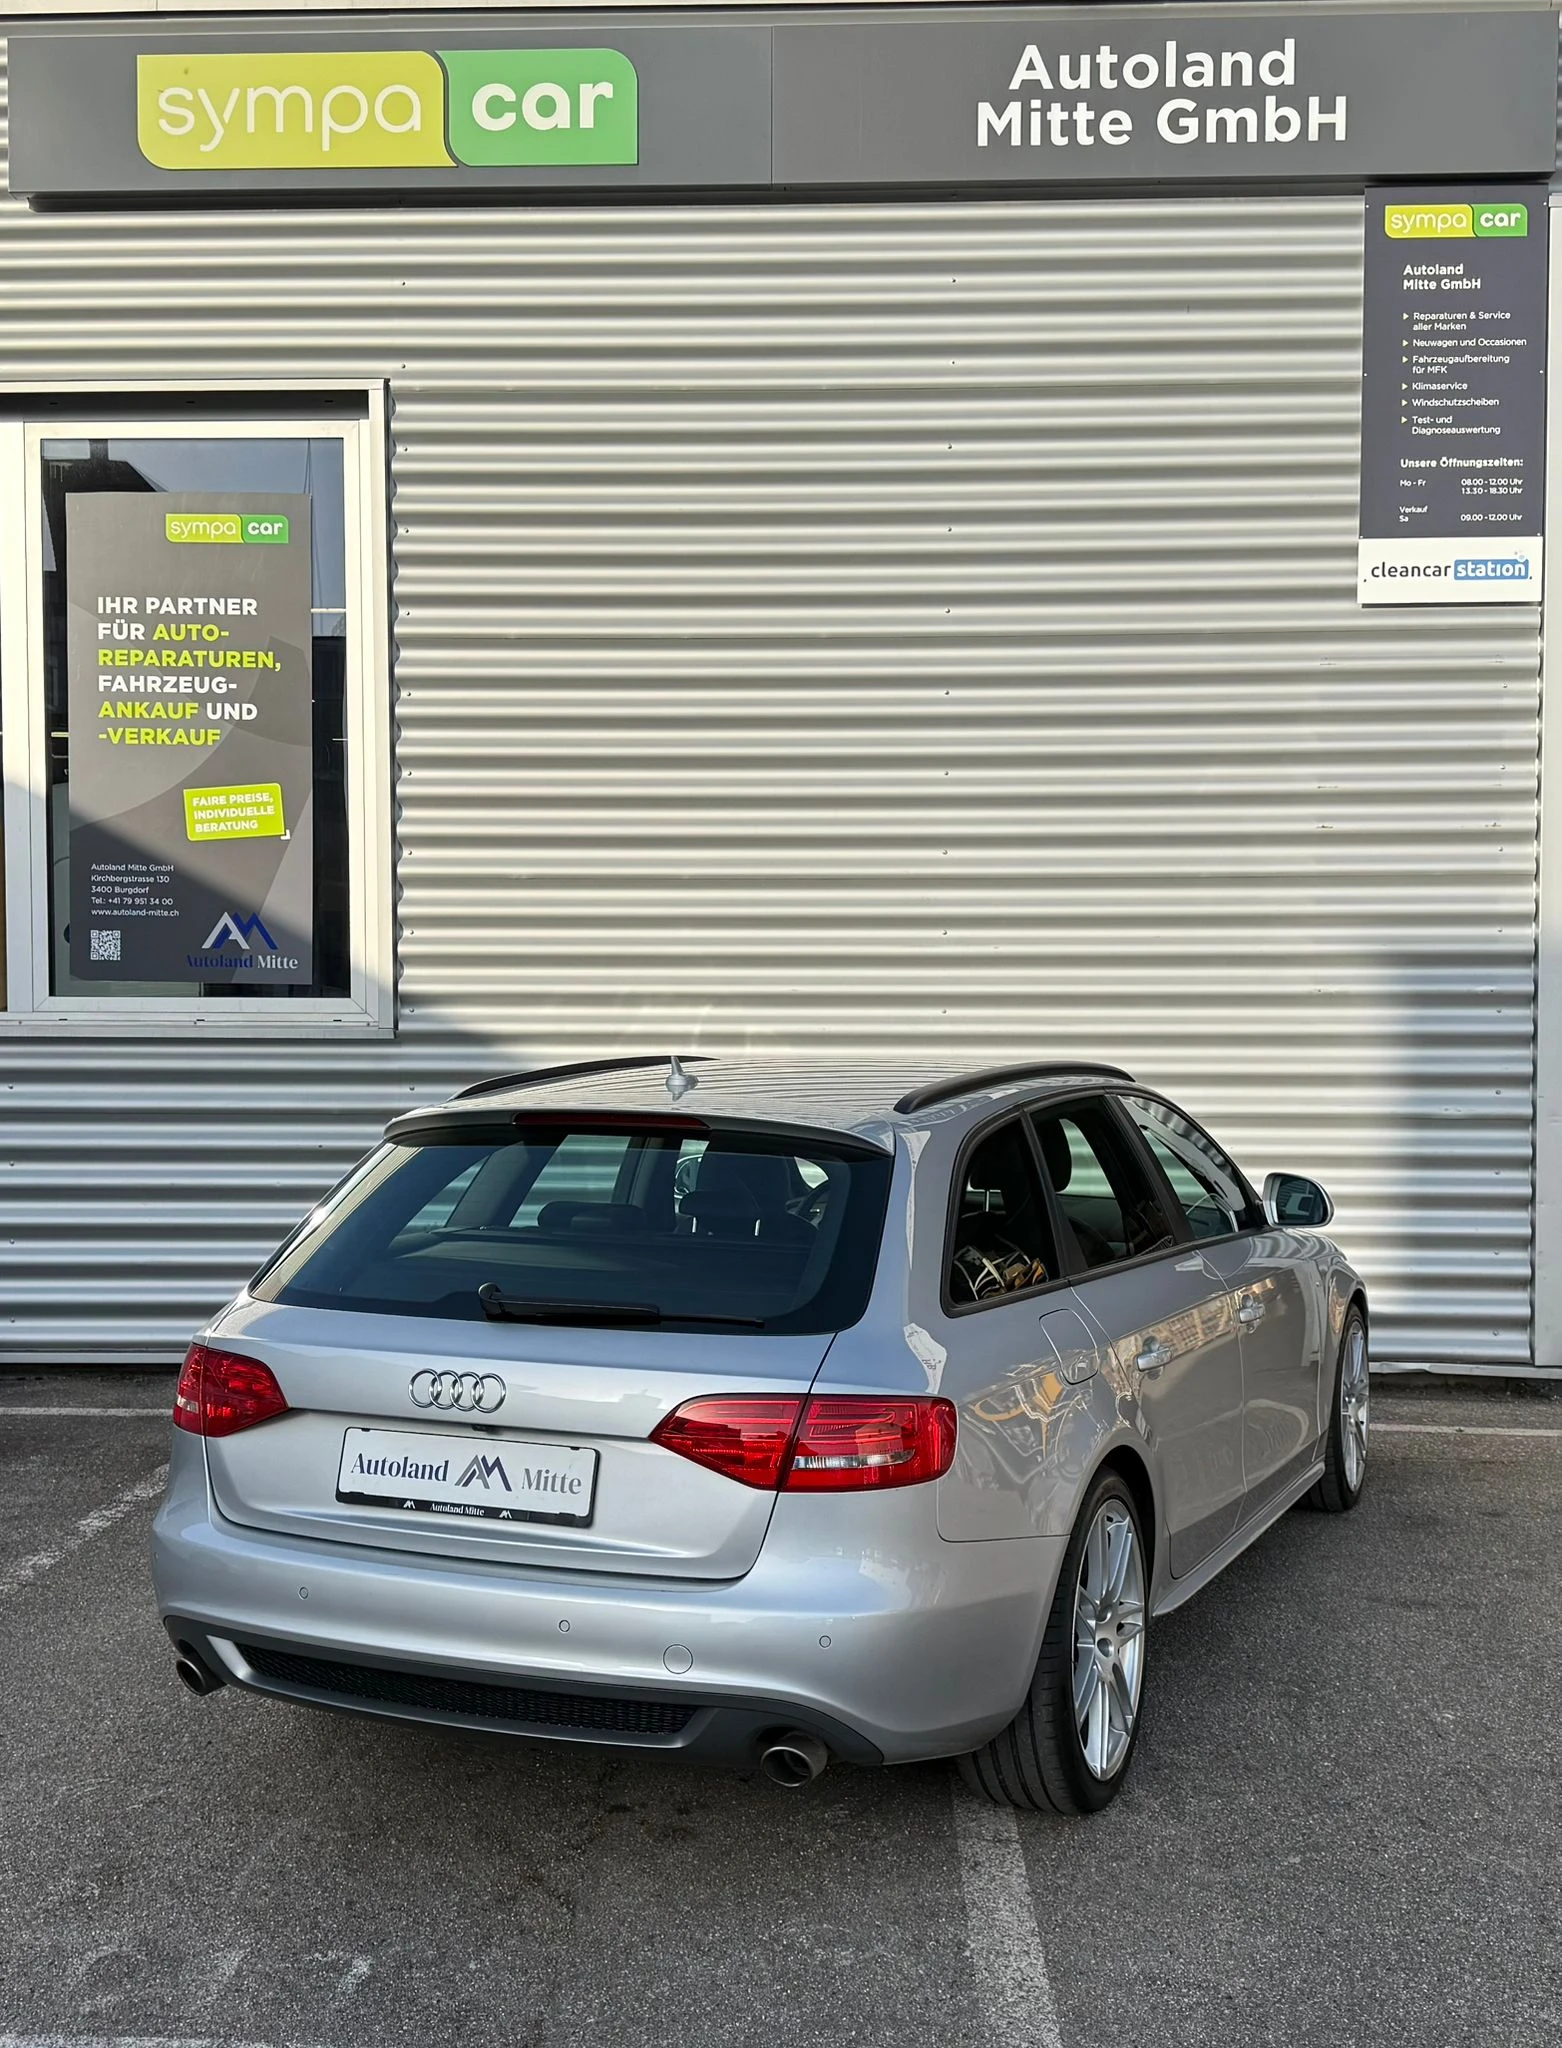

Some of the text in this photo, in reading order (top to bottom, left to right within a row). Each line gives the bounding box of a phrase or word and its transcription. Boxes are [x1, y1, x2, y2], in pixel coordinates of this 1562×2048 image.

[1008, 38, 1297, 91] Autoland
[157, 81, 614, 152] sympa car
[976, 95, 1348, 147] Mitte GmbH
[1390, 211, 1521, 233] sympa car
[1402, 263, 1464, 276] Autoland
[1402, 278, 1482, 290] Mitte GmbH
[1413, 311, 1511, 322] Reparaturen & Service
[1412, 322, 1467, 331] aller Marken
[1412, 337, 1527, 348] Neuwagen und Occasionen
[1412, 354, 1510, 365] Fahrzeugaufbereitung
[1412, 365, 1448, 374] für MFK
[1412, 382, 1468, 391] Klimaservice
[1411, 397, 1500, 407] Windschutzscheiben
[1411, 415, 1453, 424] Test- und
[1411, 426, 1501, 435] Diagnoseauswertung
[1400, 456, 1524, 469] Unsere Öffnungszeiten:
[1399, 479, 1412, 487] Mo
[1417, 479, 1426, 487] Fr
[1461, 478, 1484, 486] 08.00
[1488, 478, 1508, 486] 12.00
[1509, 478, 1523, 486] Uhr
[1461, 487, 1484, 495] 13.30
[1489, 487, 1508, 495] 18.30
[1399, 505, 1428, 514] Verkauf
[1399, 514, 1409, 522] Sa
[1460, 514, 1484, 522] 09.00
[1508, 513, 1522, 521] Uhr
[170, 520, 284, 539] sympa car
[1371, 561, 1527, 578] cleancar station
[98, 596, 258, 616] IHR PARTNER
[98, 618, 230, 642] FÜR AUTO-
[98, 649, 281, 671] REPARATUREN,
[98, 675, 238, 694] FAHRZEUG-
[98, 701, 258, 721] ANKAUF UND
[98, 728, 221, 746] -VERKAUF
[192, 792, 274, 807] FAIRE PREISE,
[193, 805, 276, 820] INDIVIDUELLE
[195, 819, 259, 833] BERATUNG
[91, 863, 126, 871] Autoland
[149, 864, 174, 872] GmbH
[91, 875, 170, 884] Kirchbergstrasse 130
[114, 886, 149, 894] Burgdorf
[123, 897, 132, 905] 79
[134, 897, 148, 905] 951
[91, 908, 180, 917] www.autoland-mitte.ch
[186, 954, 299, 969] Autoland Mitte
[351, 1452, 449, 1483] Autoland
[521, 1468, 582, 1495] Mitte
[430, 1503, 464, 1514] Autoland
[464, 1506, 485, 1516] Mitte
